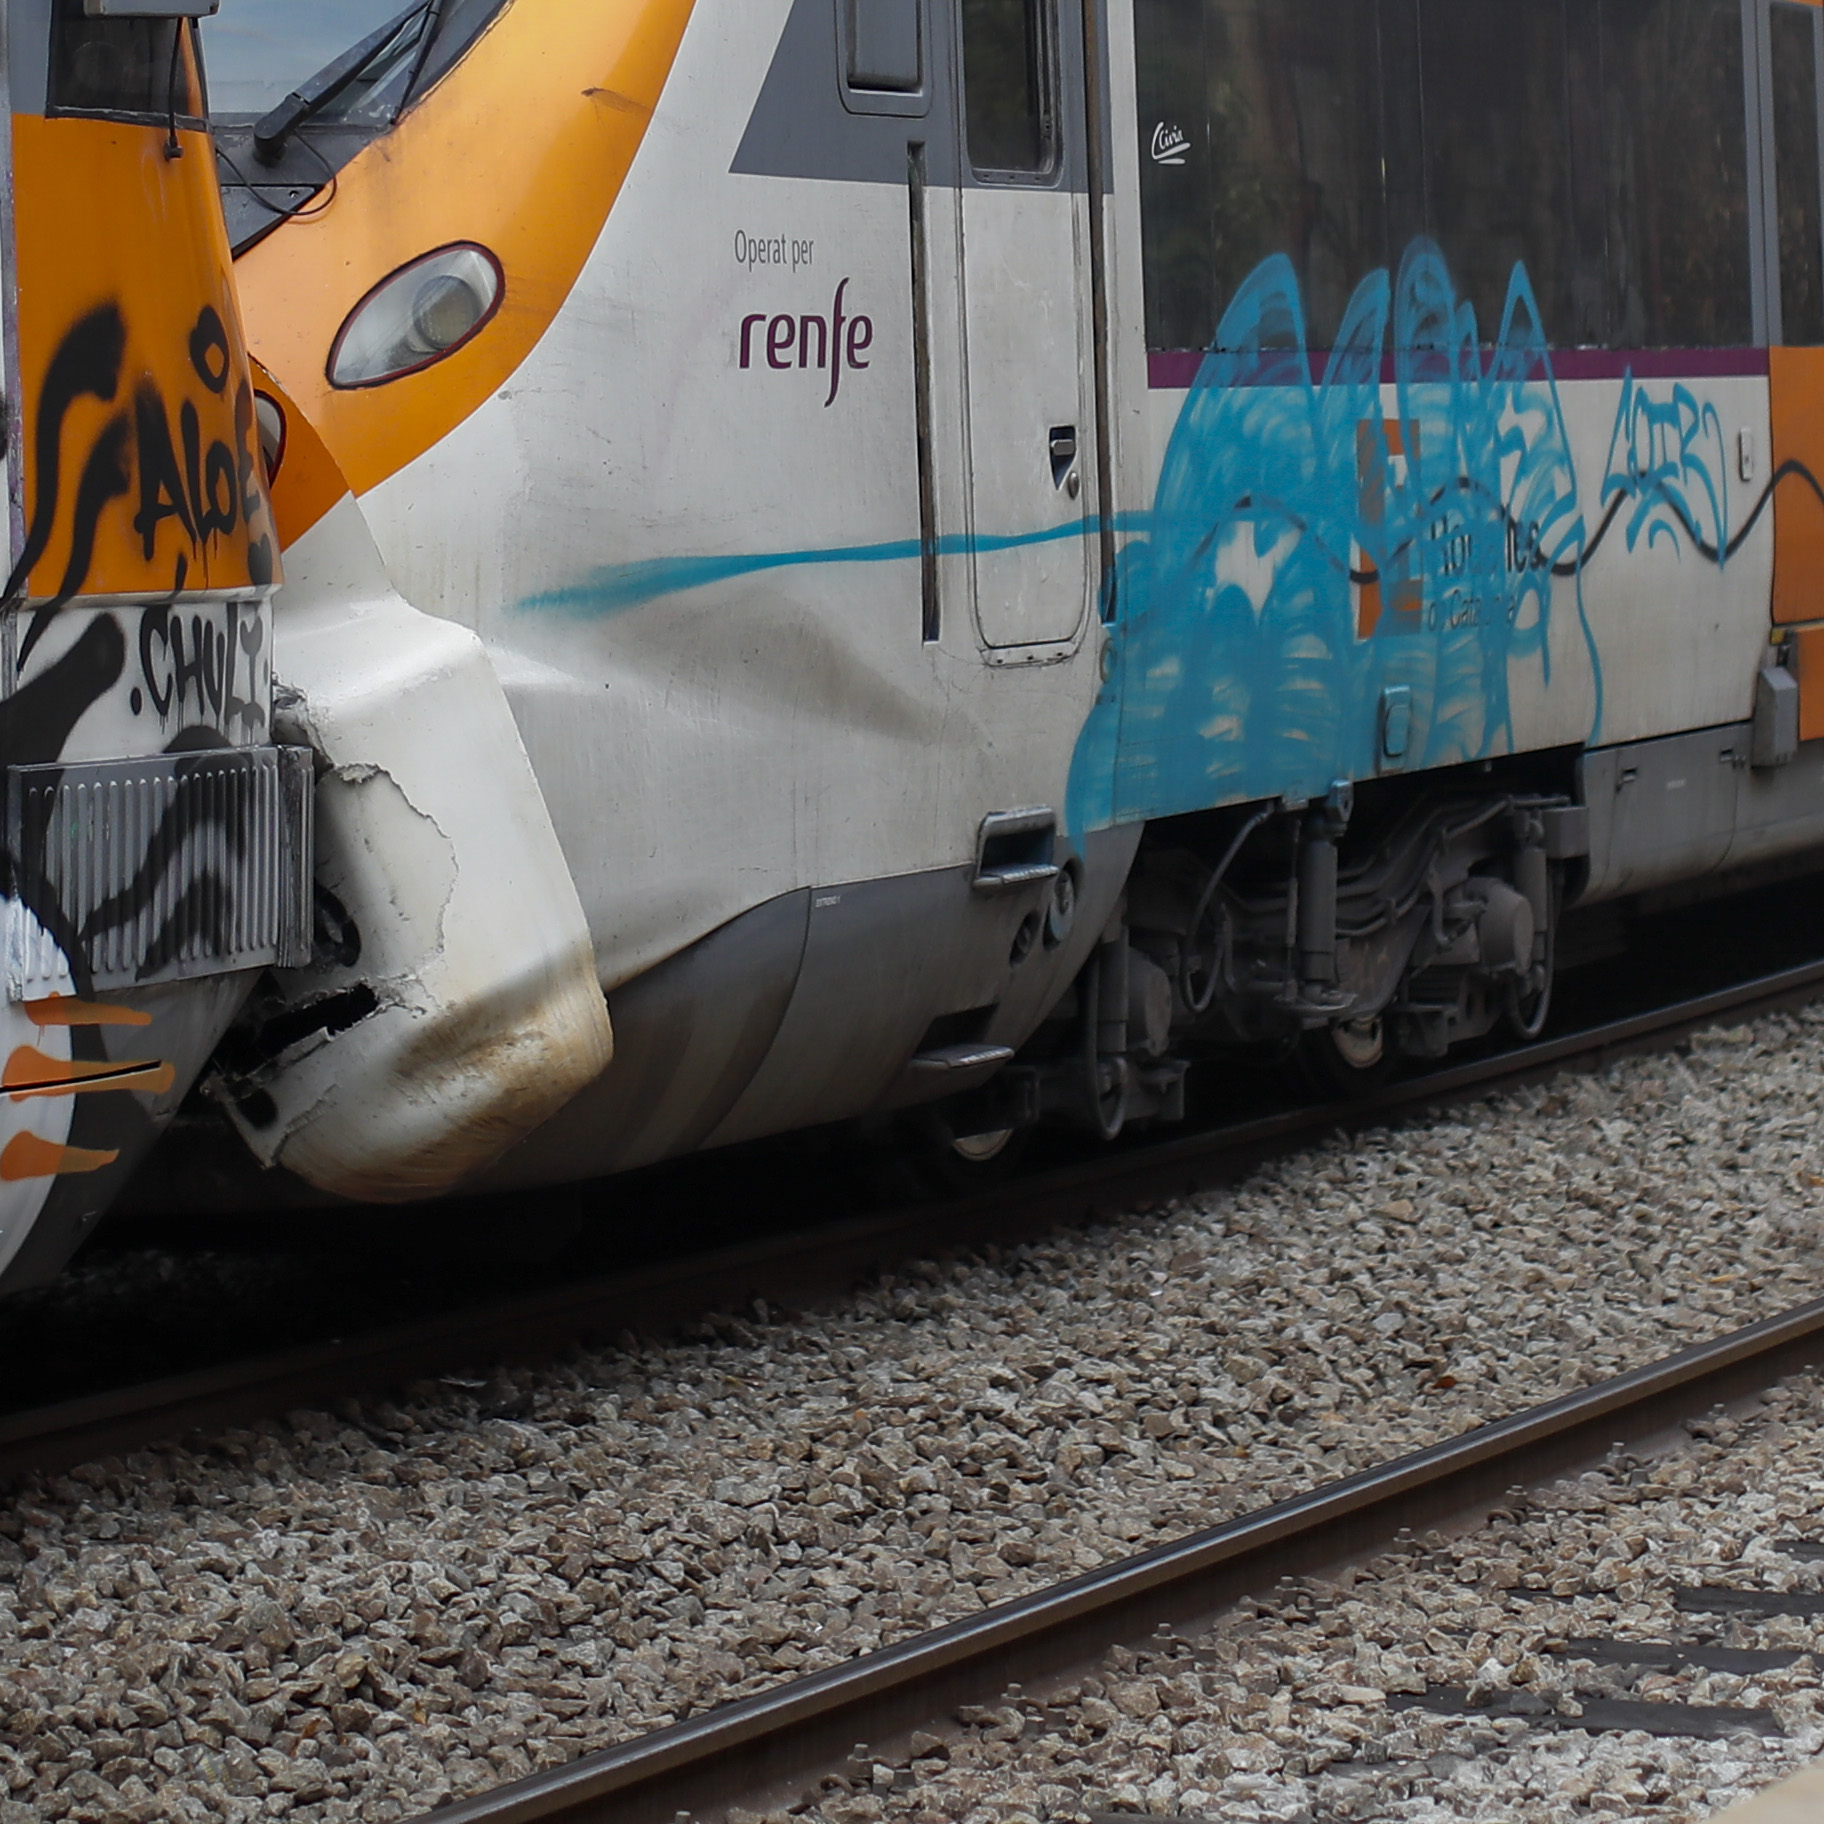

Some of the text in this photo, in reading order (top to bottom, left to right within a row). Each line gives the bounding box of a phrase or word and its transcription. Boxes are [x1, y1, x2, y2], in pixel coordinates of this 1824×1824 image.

[734, 229, 815, 274] Operat per
[738, 276, 873, 408] renfe
